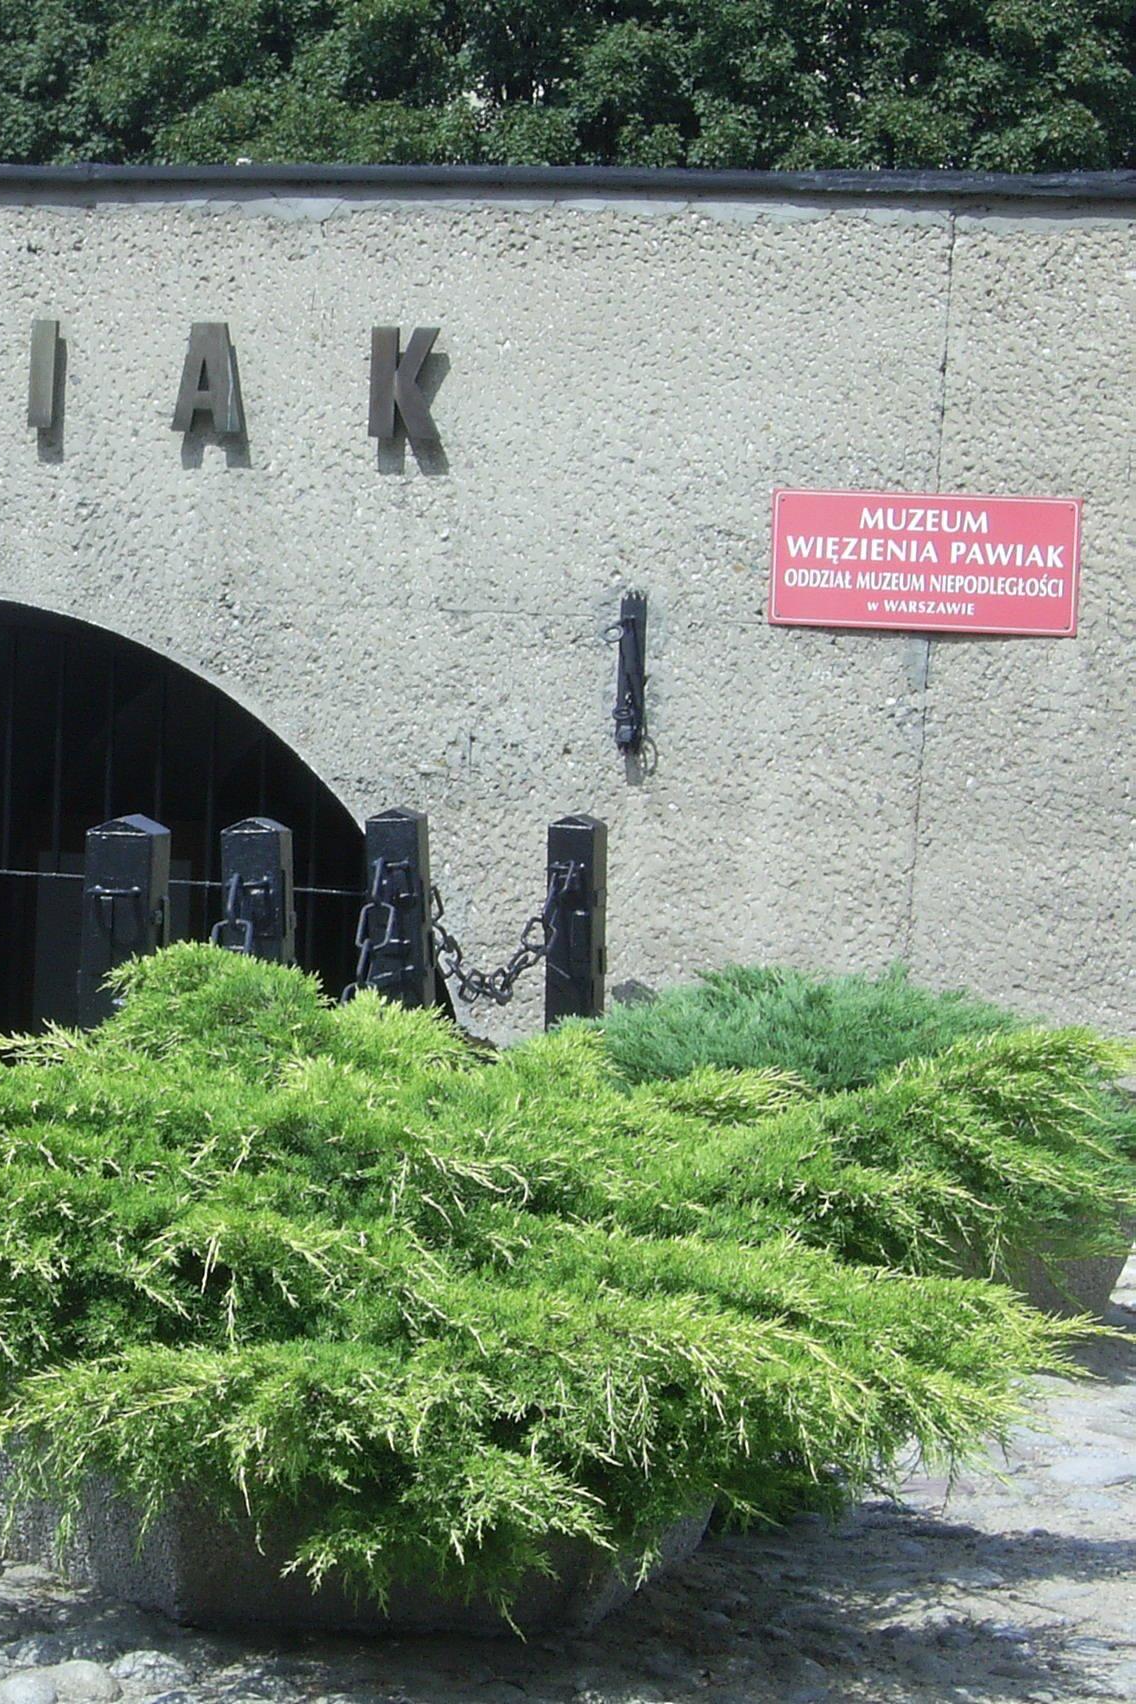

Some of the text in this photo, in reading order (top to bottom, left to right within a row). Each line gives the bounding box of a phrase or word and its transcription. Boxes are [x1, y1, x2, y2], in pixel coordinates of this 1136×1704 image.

[859, 507, 988, 533] MUZEUM
[786, 535, 1064, 568] WIĘZIENIA PAWIAK
[784, 568, 1064, 598] ODDZIAŁ MUZEUM NIEPODLEGŁOŚCI
[867, 600, 975, 616] w WARSZAWIE
